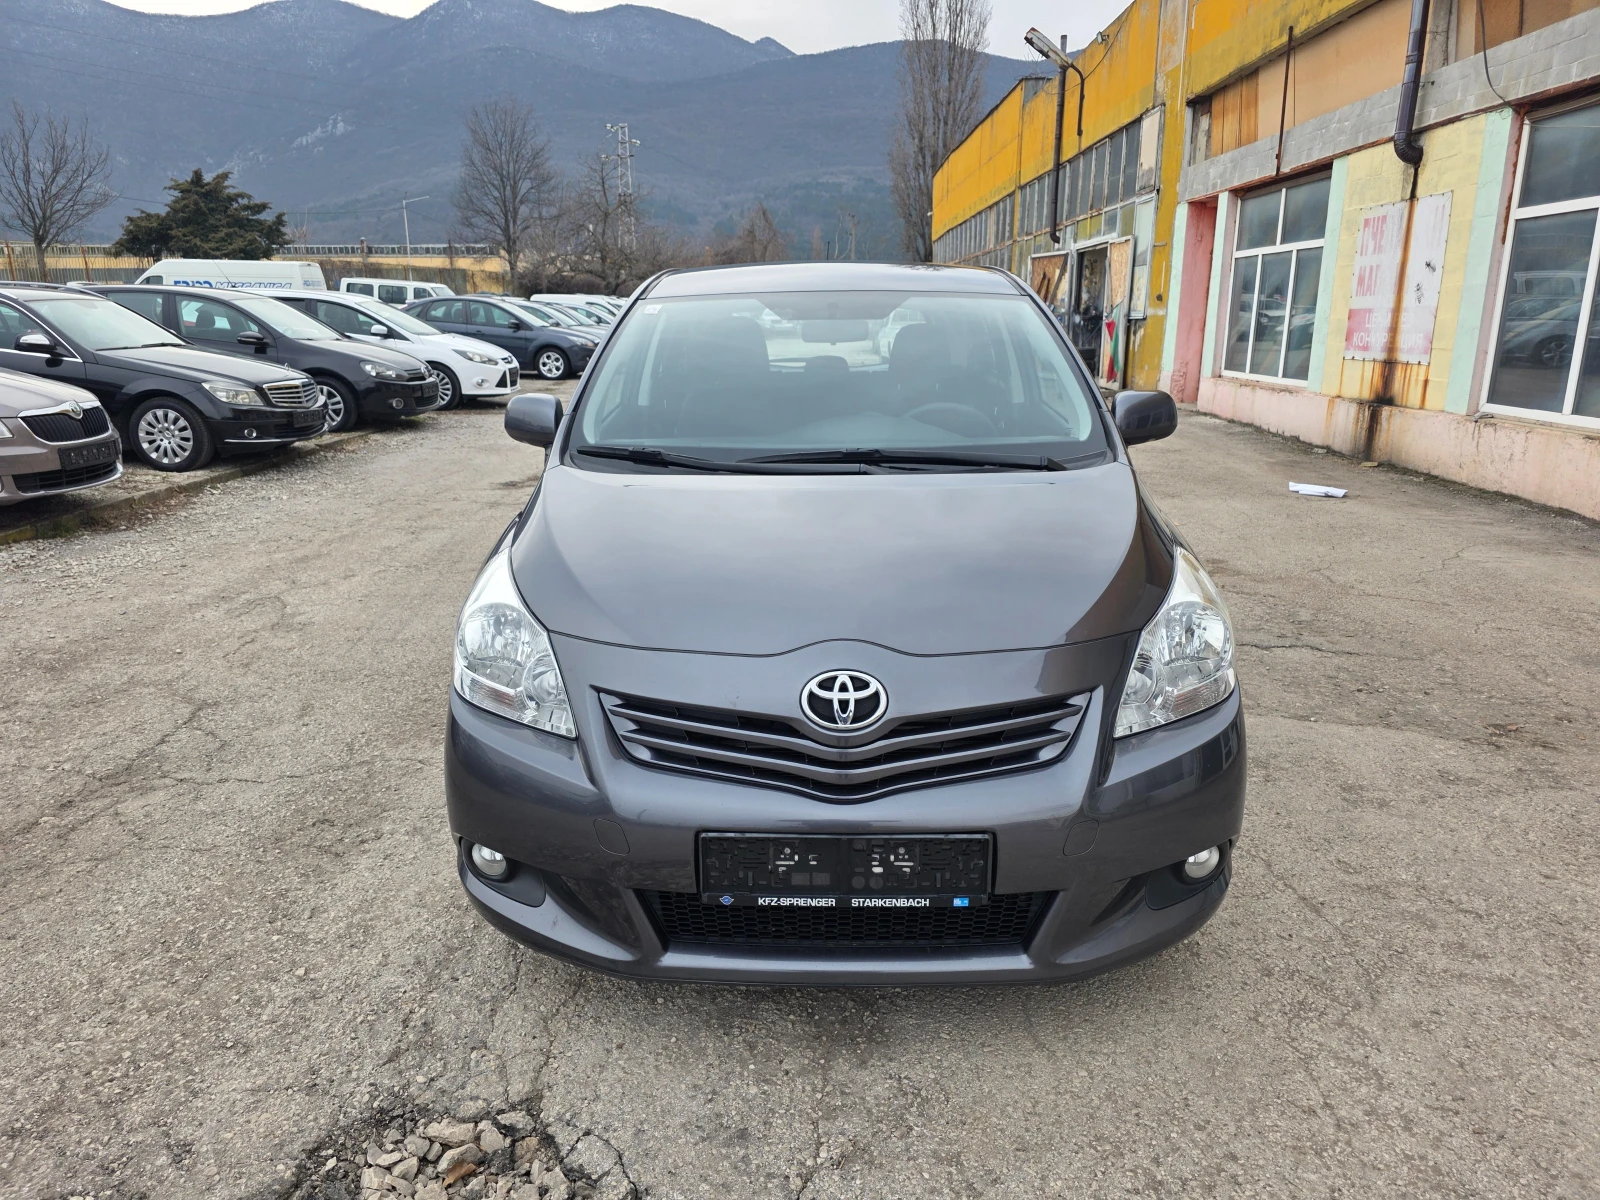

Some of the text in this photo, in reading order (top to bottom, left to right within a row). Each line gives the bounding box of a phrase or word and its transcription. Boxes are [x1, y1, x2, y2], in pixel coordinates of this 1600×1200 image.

[1352, 331, 1424, 351] КОНКУРЕЦИЯ
[757, 897, 930, 907] KFZ-SPRENGER STARKENBACH
